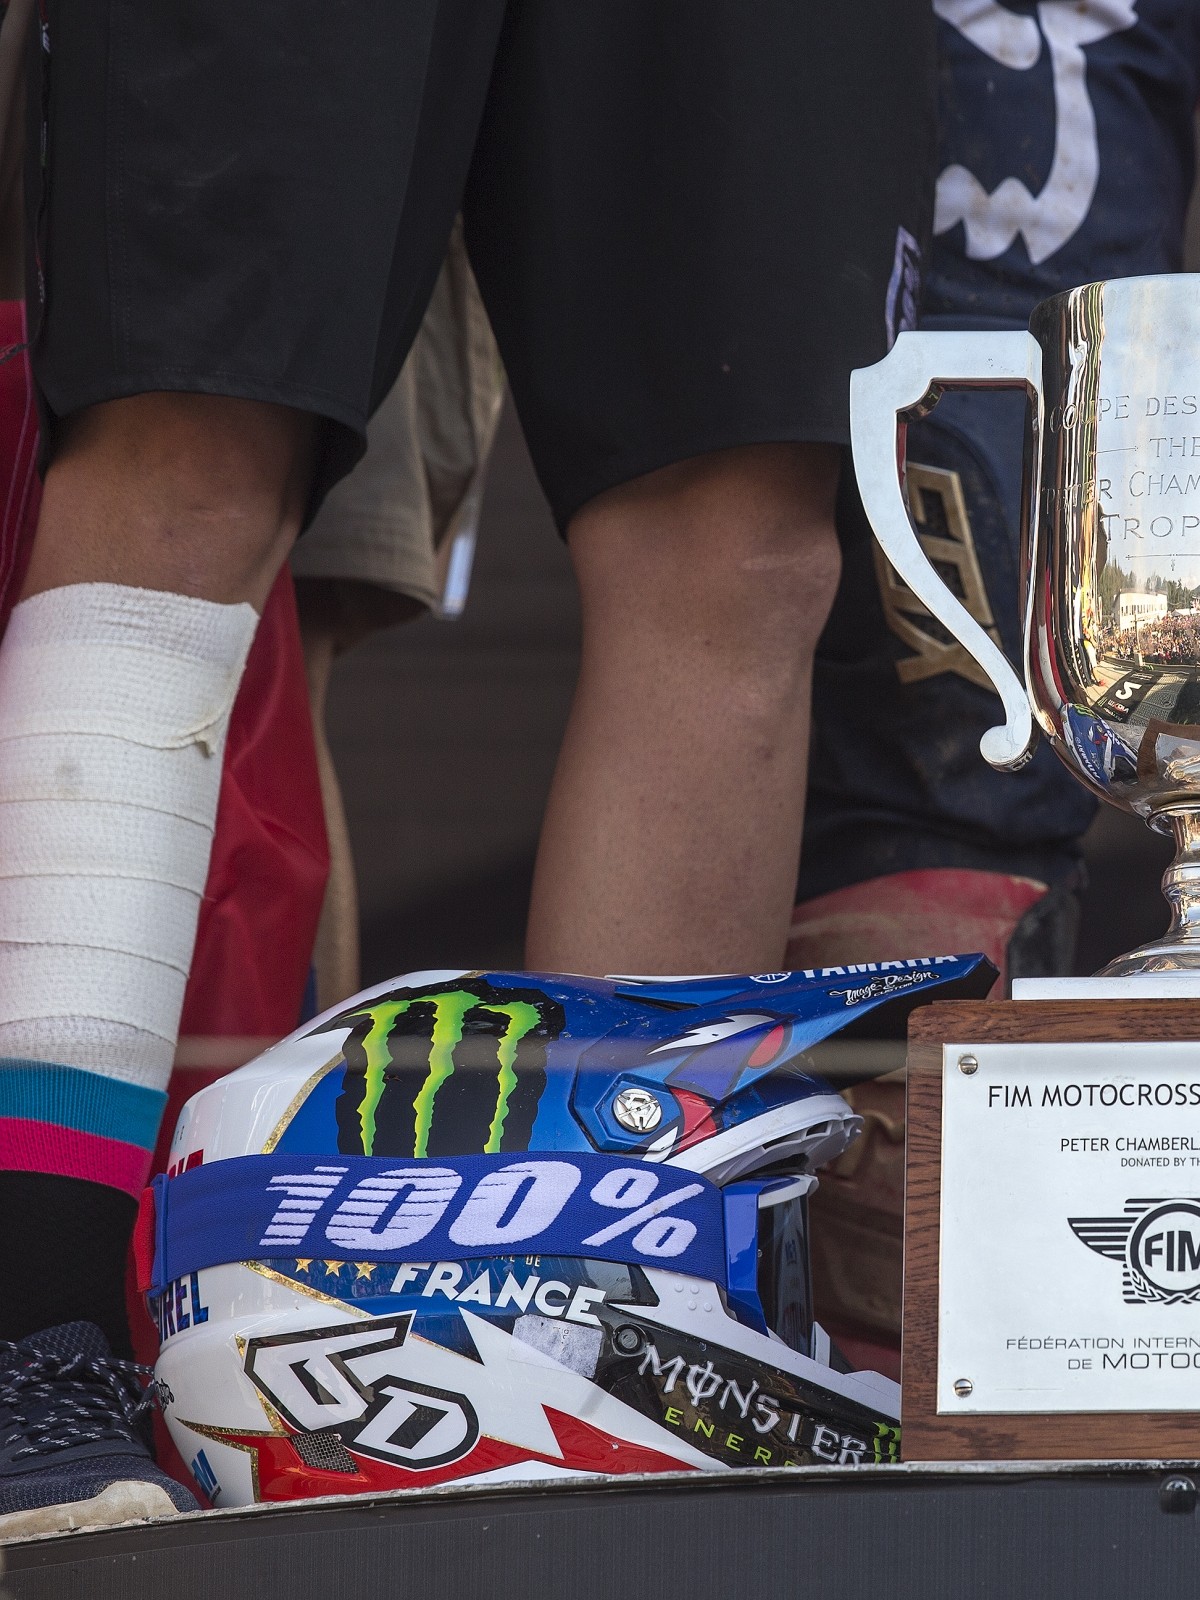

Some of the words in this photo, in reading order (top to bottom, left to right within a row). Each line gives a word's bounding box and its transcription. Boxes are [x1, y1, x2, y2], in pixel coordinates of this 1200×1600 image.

[1145, 394, 1198, 416] DES
[988, 1085, 1033, 1108] FIM
[1060, 1137, 1110, 1152] PETER
[1120, 1157, 1170, 1168] DONATED
[1173, 1157, 1187, 1167] BY
[259, 1161, 706, 1258] 100%
[390, 1262, 607, 1327] FRANCE
[1006, 1335, 1124, 1350] FÉDÉRATION
[1067, 1358, 1092, 1370] DE
[637, 1342, 868, 1465] MONSTER
[665, 1406, 800, 1467] ENER
